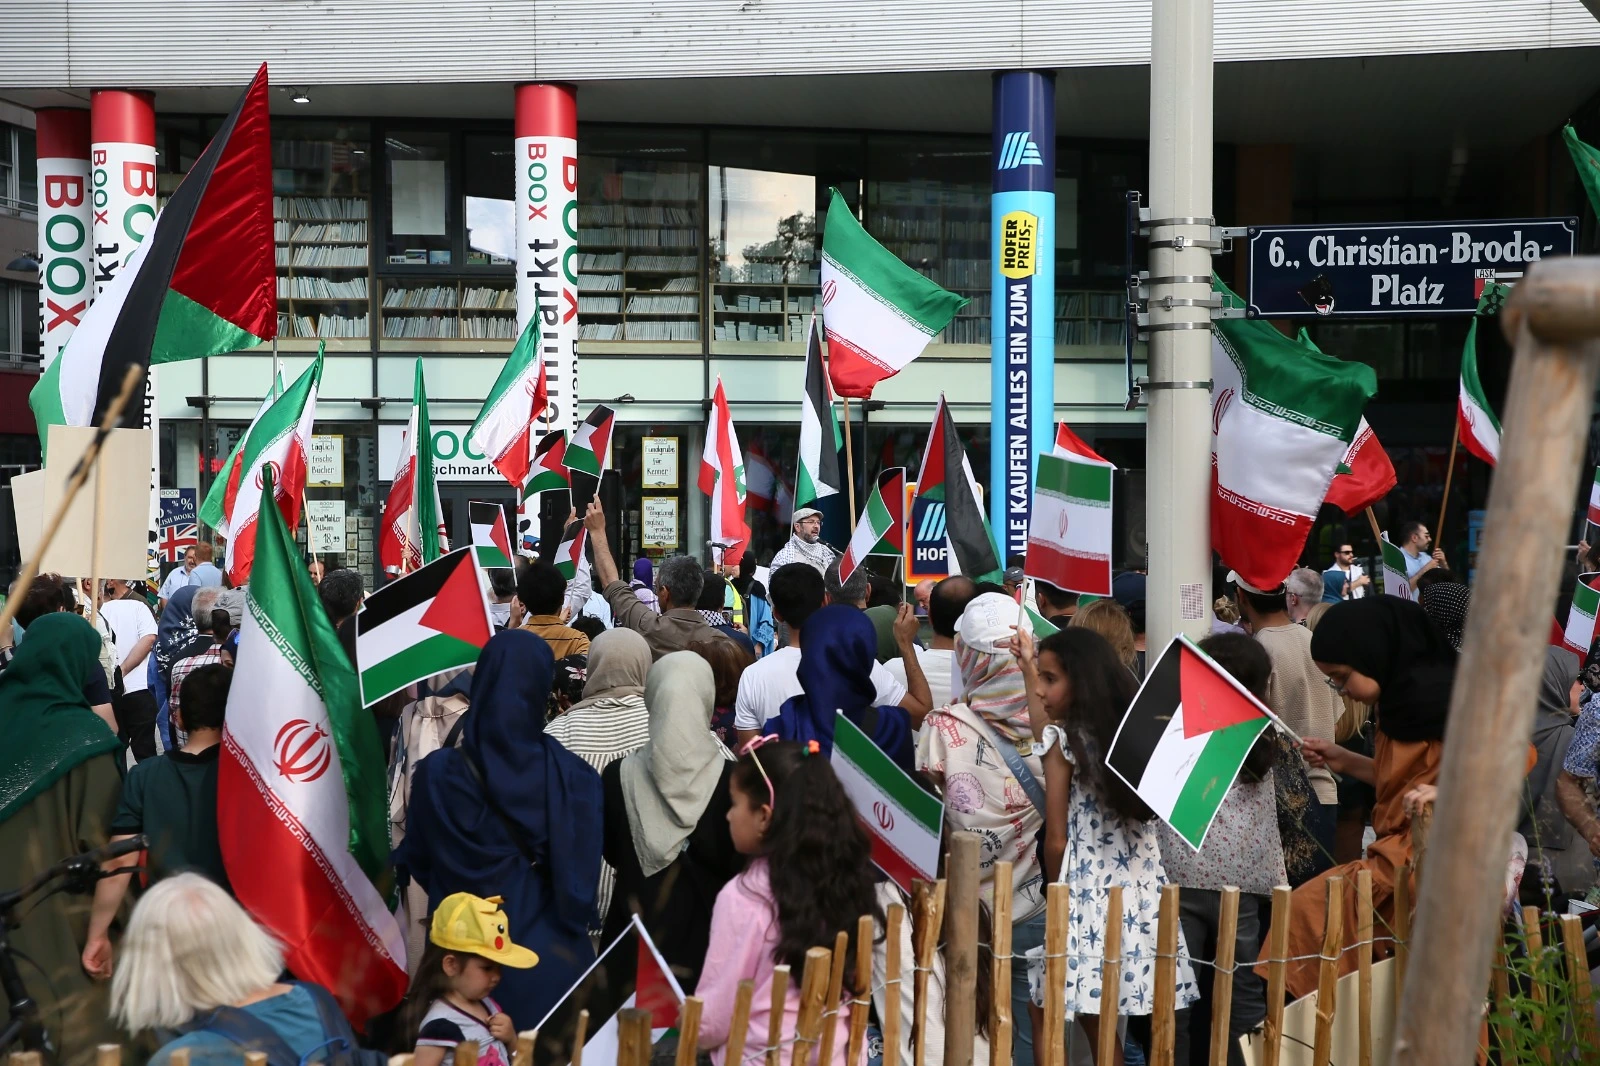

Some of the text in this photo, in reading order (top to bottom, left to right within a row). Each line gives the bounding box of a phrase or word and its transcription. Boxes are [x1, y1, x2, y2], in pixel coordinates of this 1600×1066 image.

[93, 149, 108, 226] BOOX
[528, 143, 548, 221] BOOX
[45, 174, 87, 333] BOOX
[1004, 219, 1018, 269] HOFER
[1308, 230, 1553, 268] Christian-Broda-
[1371, 273, 1445, 307] Platz
[1475, 269, 1494, 278] LASK
[1010, 284, 1028, 327] ZUM
[1010, 333, 1028, 364] EIN
[1010, 370, 1028, 429] ALLES
[1010, 434, 1028, 513] KAUFEN
[173, 513, 195, 521] BOOKS
[916, 547, 947, 561] HOF
